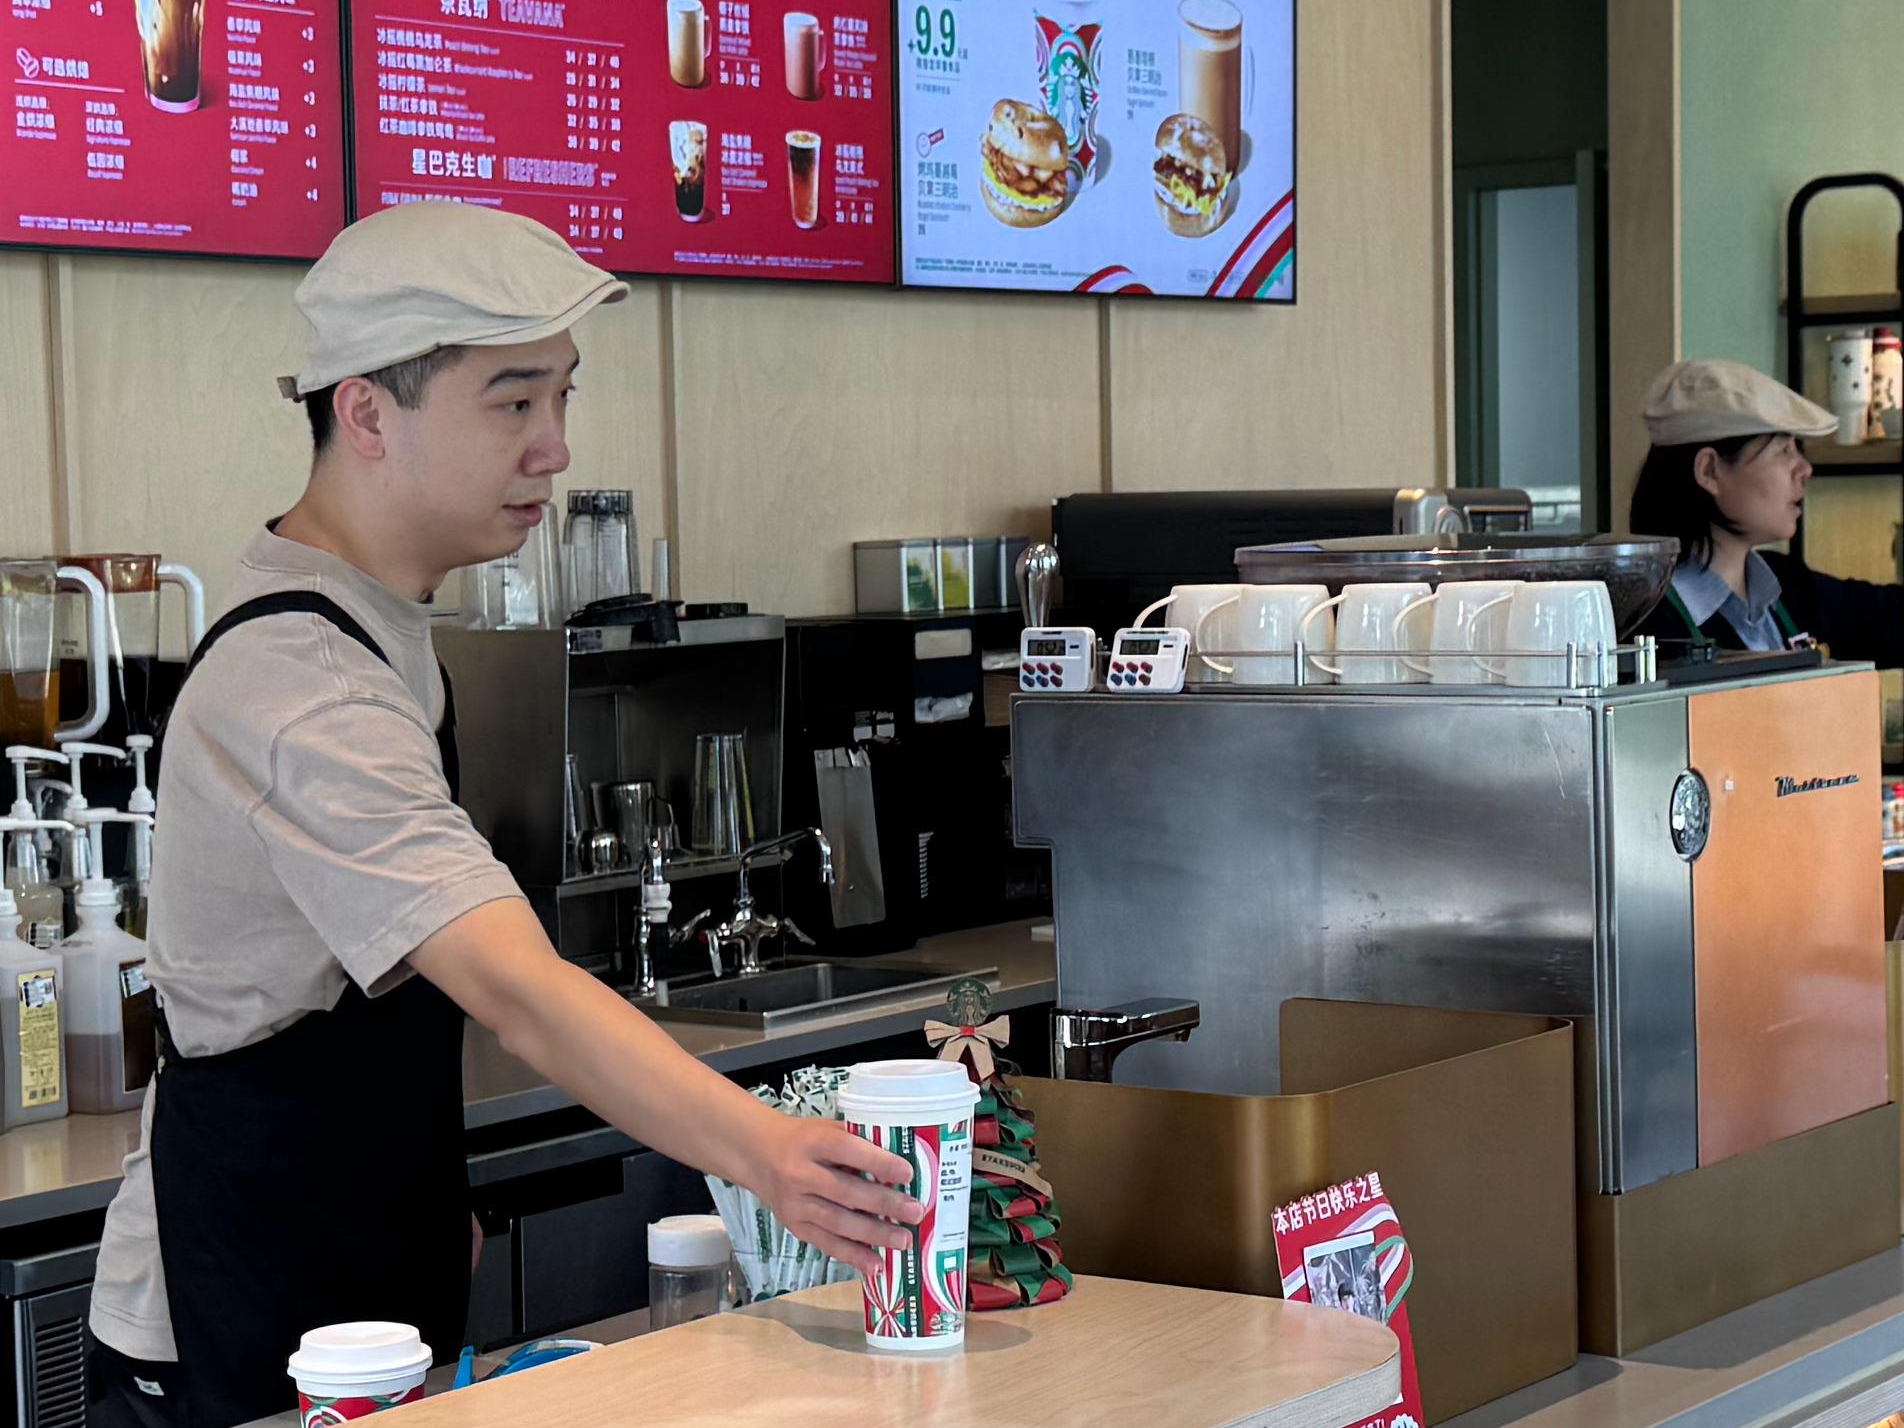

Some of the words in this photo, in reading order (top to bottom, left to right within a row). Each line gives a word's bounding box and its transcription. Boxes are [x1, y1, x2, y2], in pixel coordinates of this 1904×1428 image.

[412, 148, 496, 180] 星巴克生咖
[1274, 1171, 1384, 1236] 本店节日快乐之星
